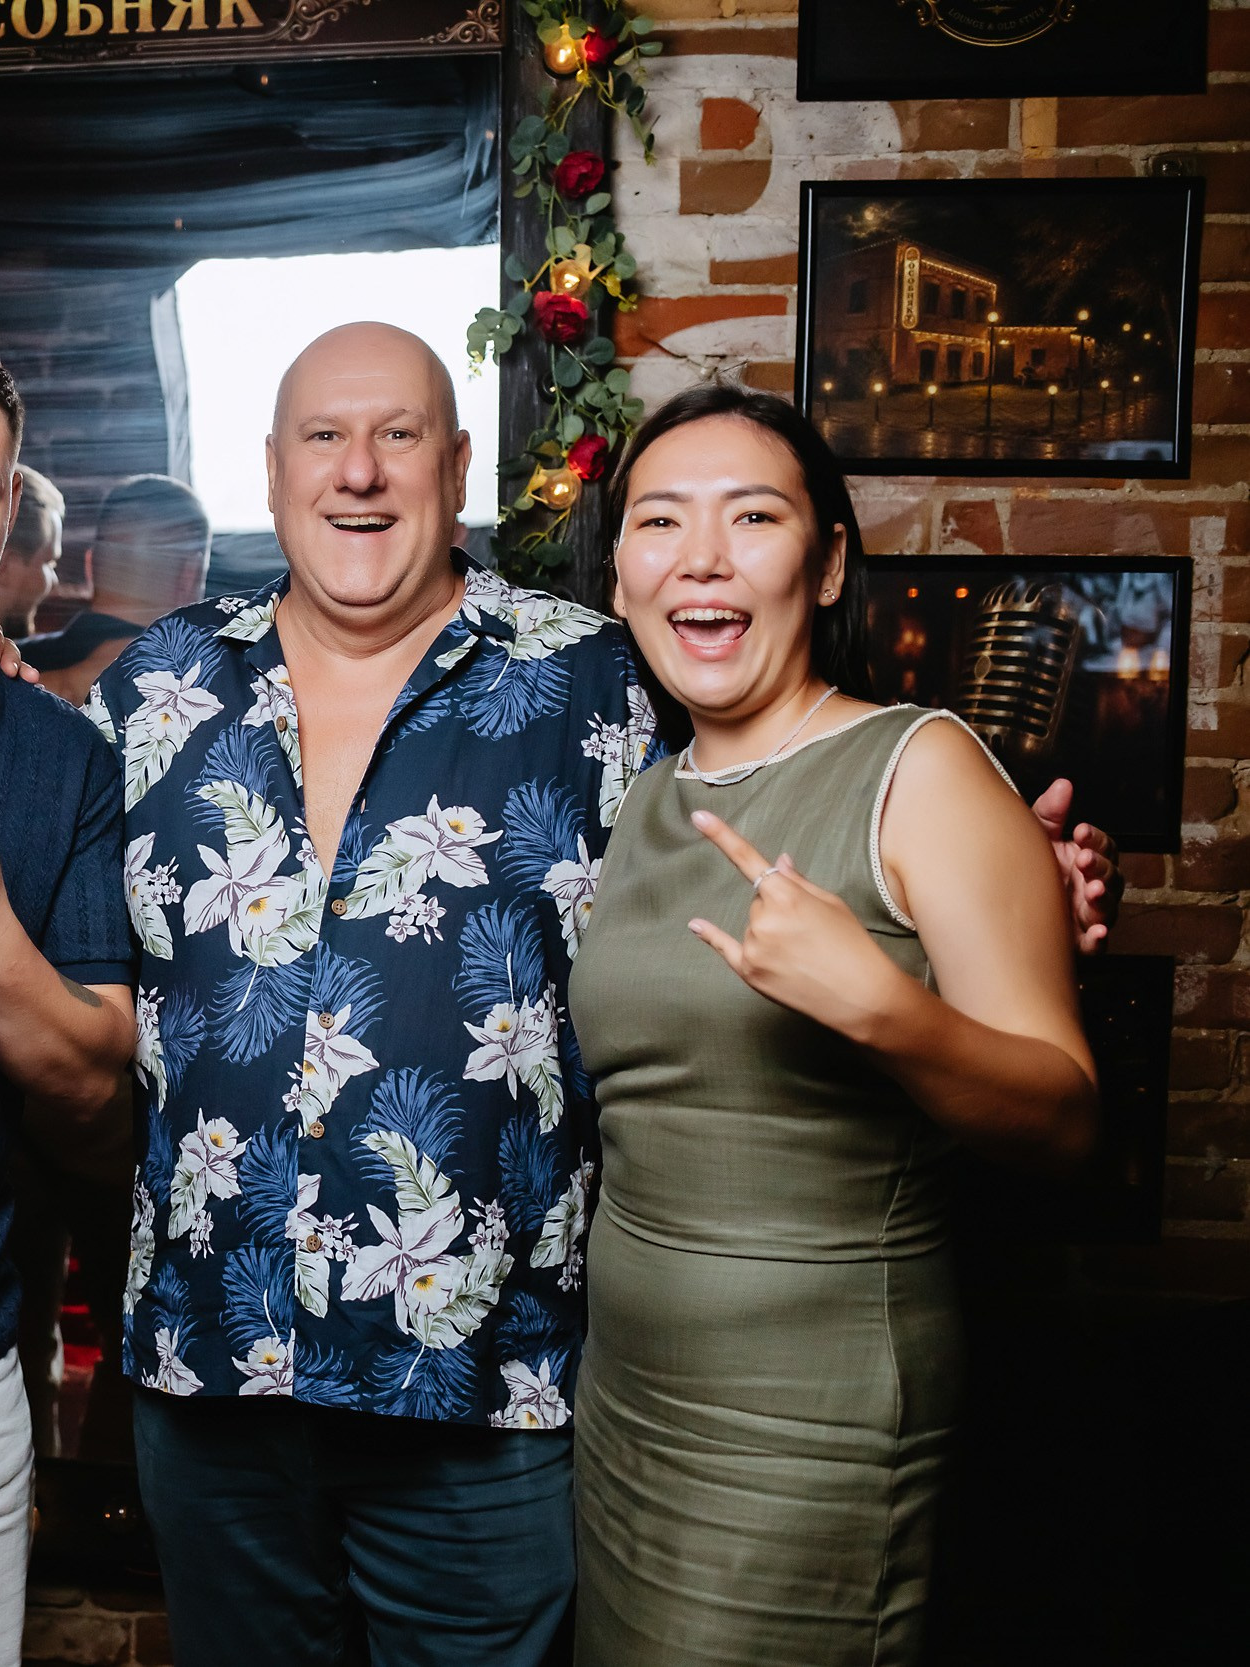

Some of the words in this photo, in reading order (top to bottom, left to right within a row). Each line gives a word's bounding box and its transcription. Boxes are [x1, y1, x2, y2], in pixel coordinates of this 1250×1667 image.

[948, 8, 985, 30] LOUNGE
[997, 20, 1016, 31] OLD
[907, 262, 915, 314] ОСОБНЯК
